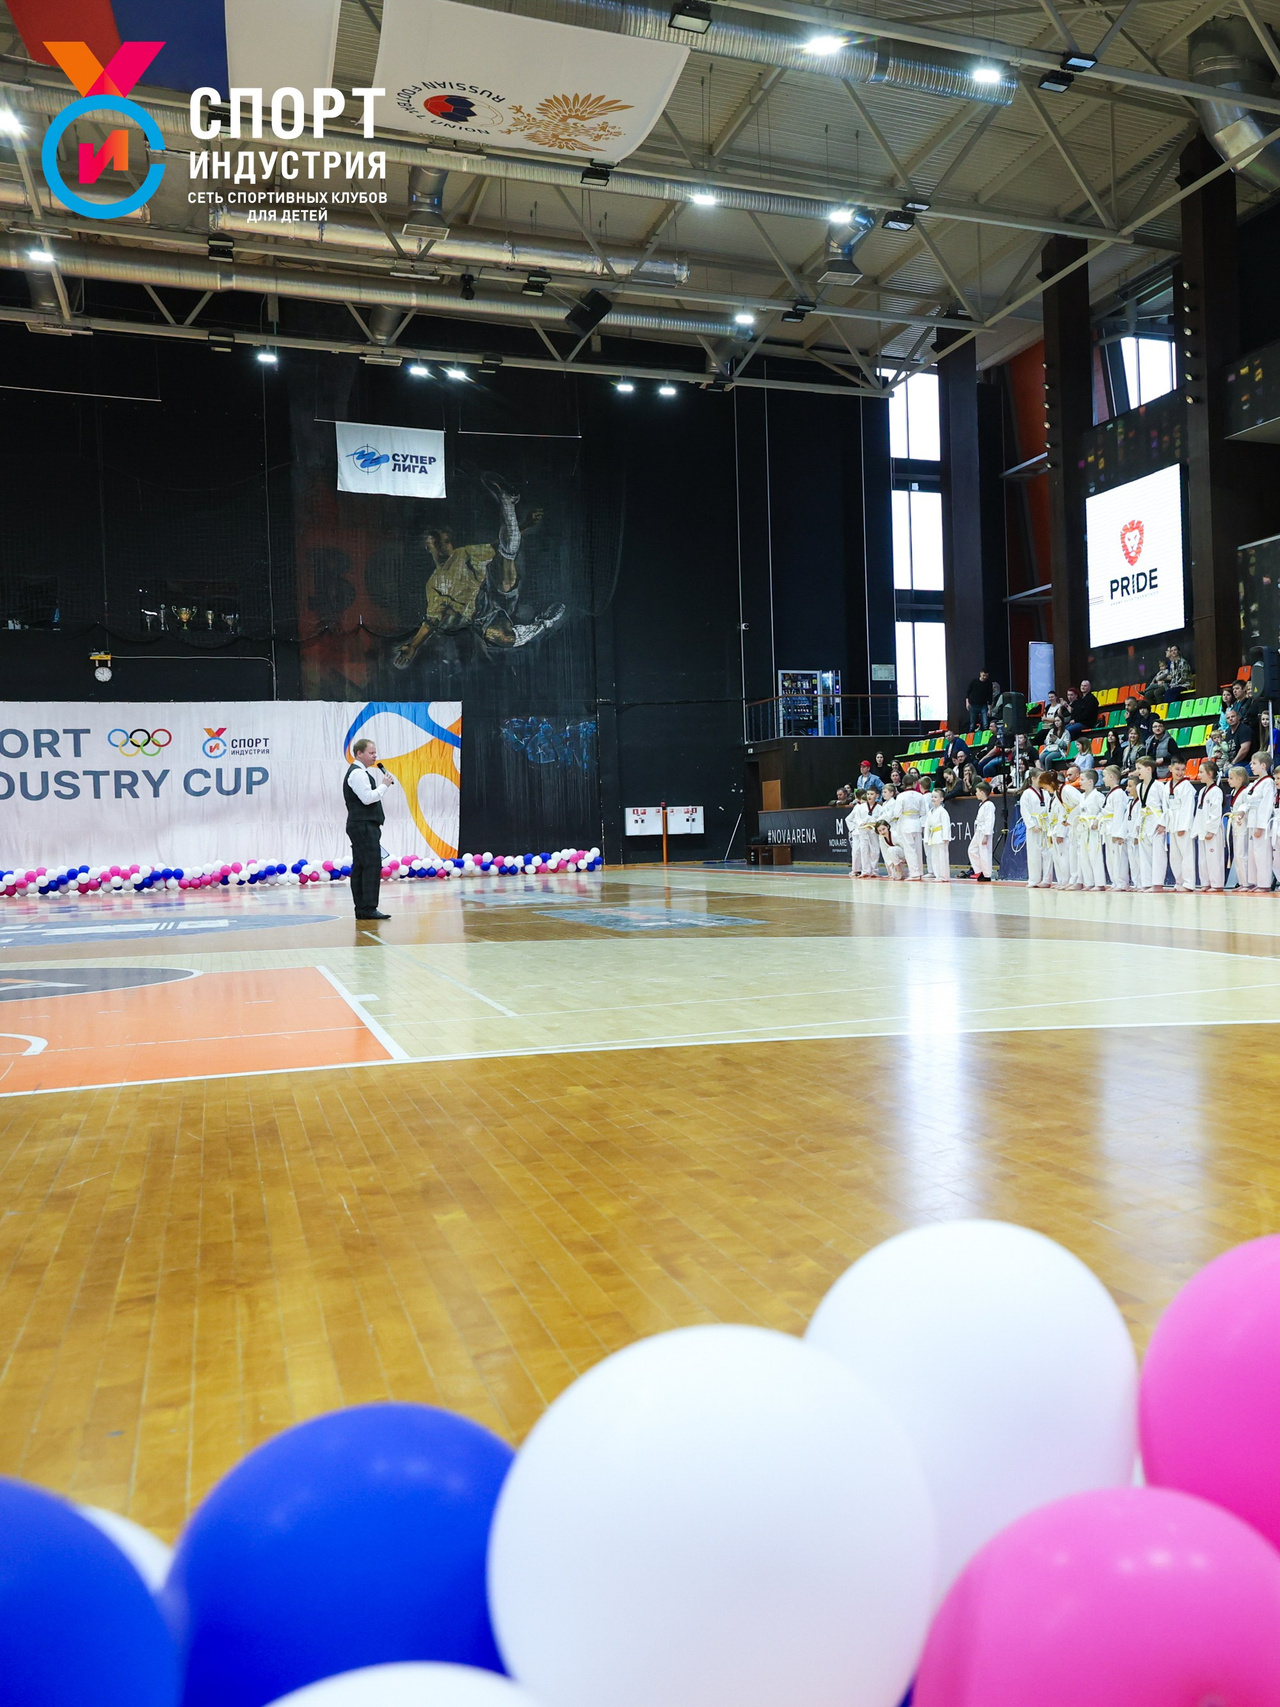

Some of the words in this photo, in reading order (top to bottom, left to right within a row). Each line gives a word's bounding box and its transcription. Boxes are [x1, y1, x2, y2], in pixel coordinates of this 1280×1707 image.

[421, 81, 506, 103] RUSSIAN
[430, 119, 490, 135] UNION
[391, 453, 437, 465] СУПЕР
[391, 463, 428, 475] ЛИГА
[1109, 567, 1158, 600] PRIDE
[230, 737, 270, 749] СПОРТ
[230, 748, 270, 756] ИНДУСТРИЯ
[183, 766, 270, 797] CUP
[767, 828, 818, 844] #NOVAARENA
